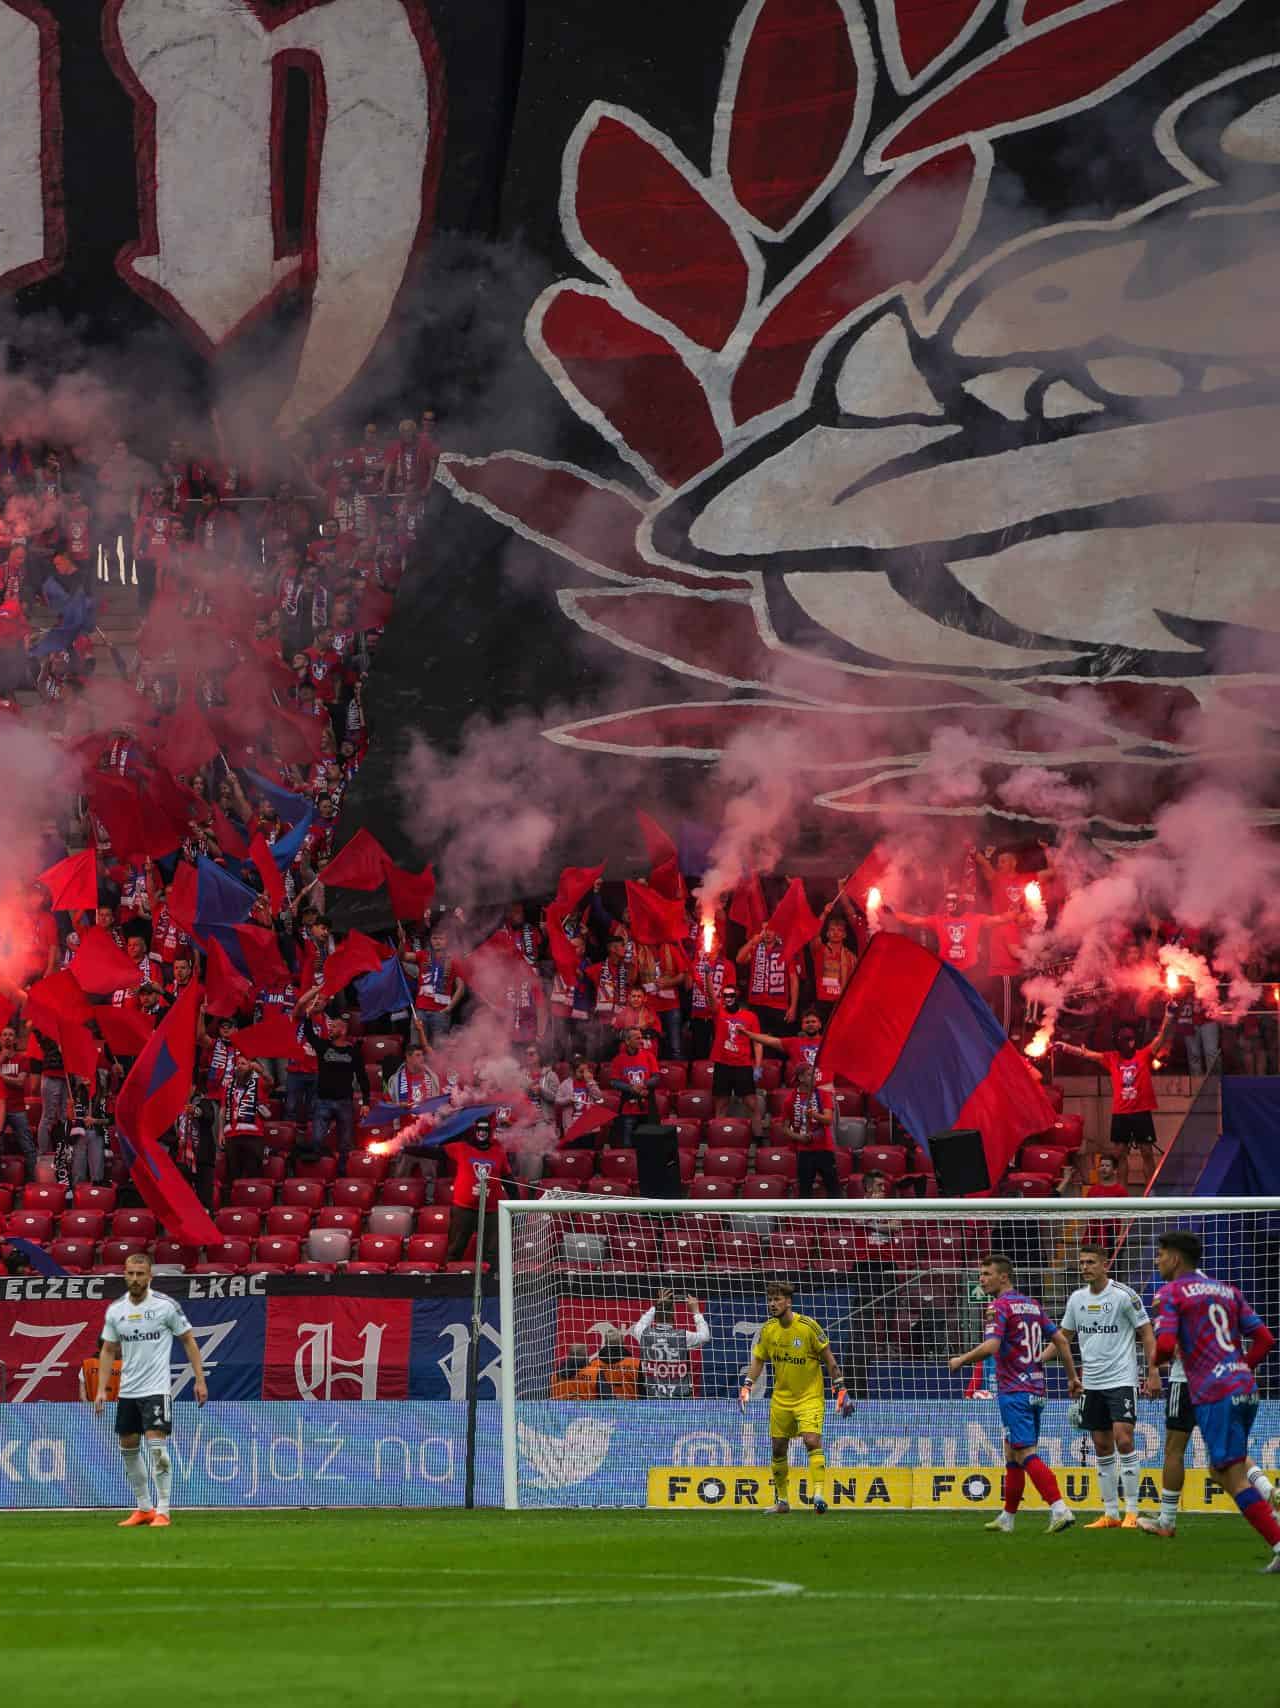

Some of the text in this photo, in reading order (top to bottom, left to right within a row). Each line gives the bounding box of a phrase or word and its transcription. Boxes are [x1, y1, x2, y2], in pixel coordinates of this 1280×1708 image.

[1017, 1320, 1042, 1363] 30
[1208, 1303, 1236, 1352] 8
[375, 1436, 453, 1481] na
[668, 1475, 1163, 1504] FORUNA FOUA
